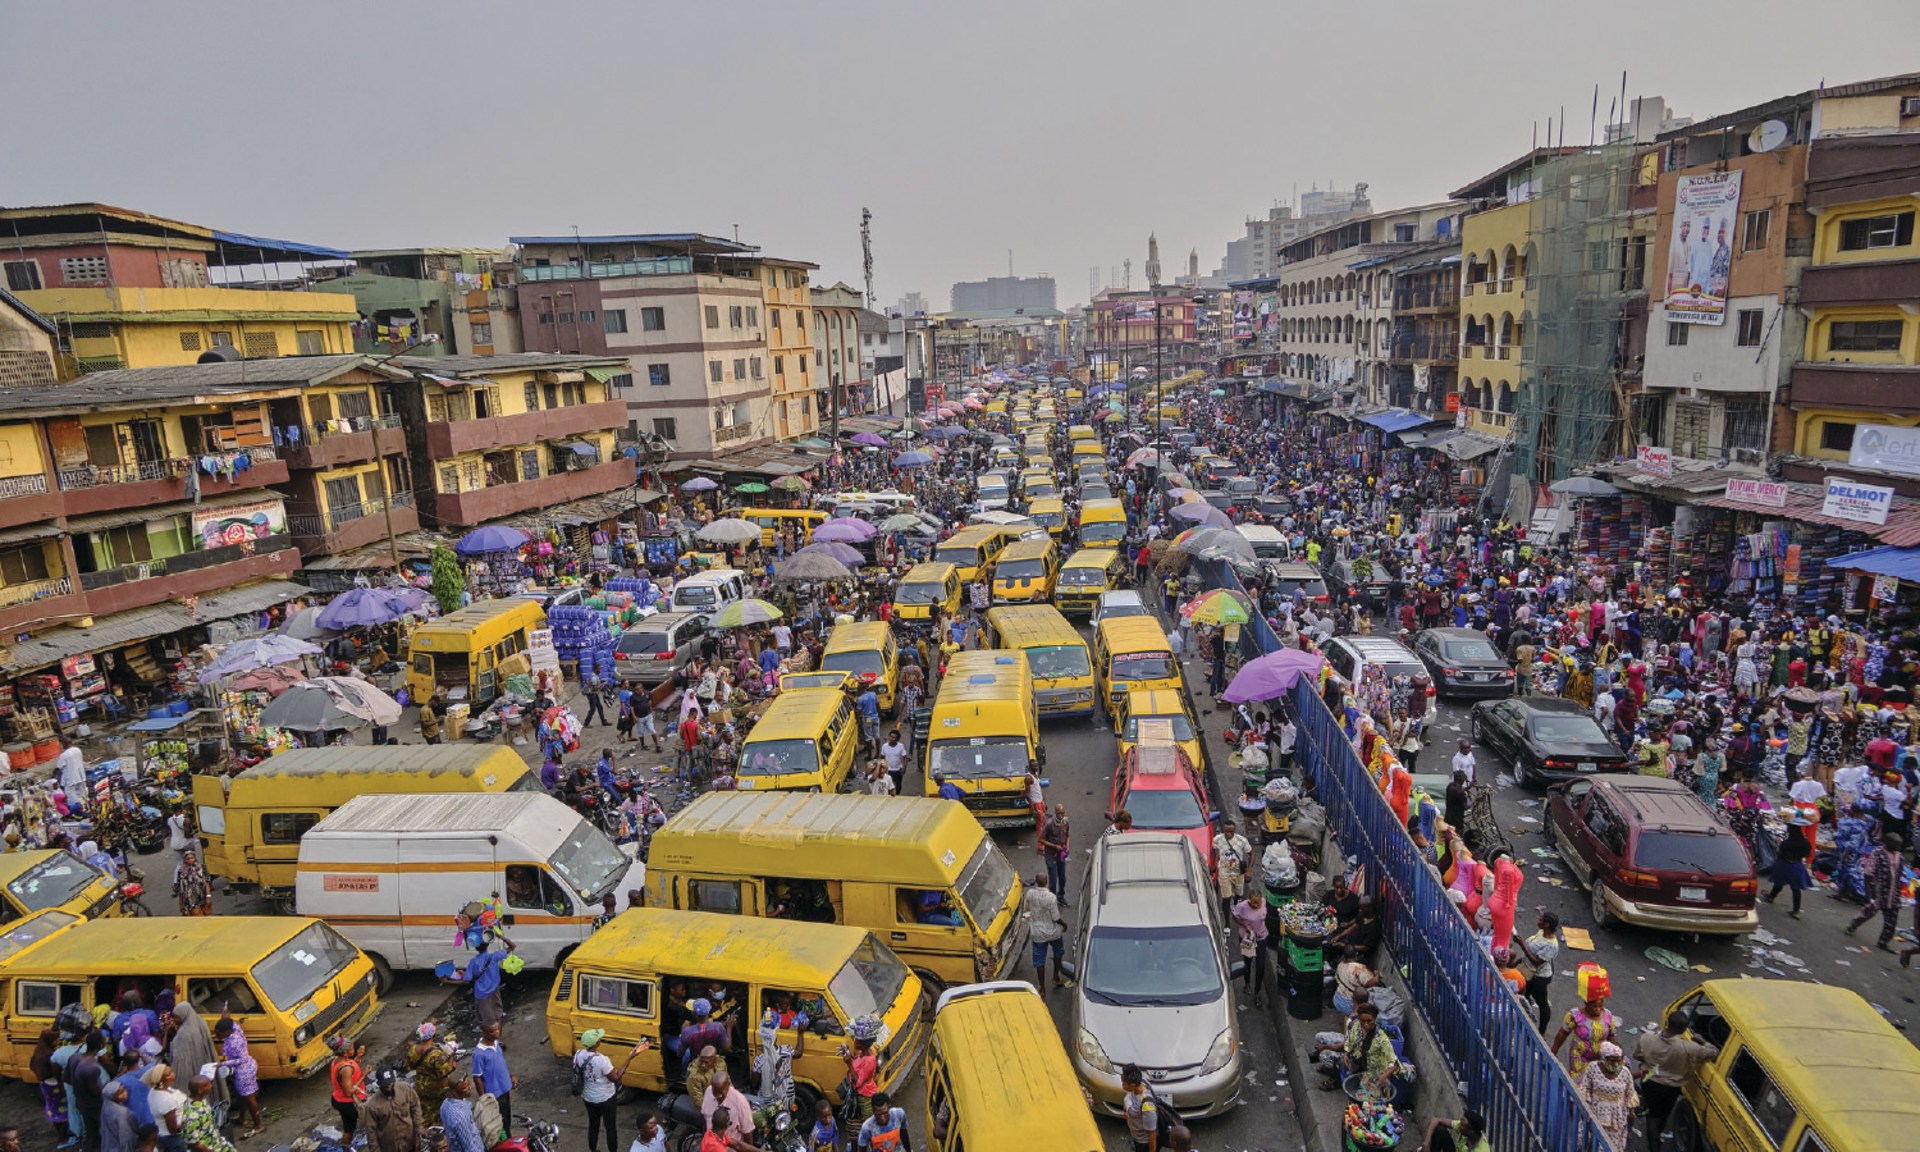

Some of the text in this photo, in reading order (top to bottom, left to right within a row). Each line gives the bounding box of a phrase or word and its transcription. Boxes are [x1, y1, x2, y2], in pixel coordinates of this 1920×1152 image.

[1729, 480, 1756, 493] DIVINE
[1757, 483, 1785, 497] MERCY
[1827, 485, 1888, 503] DELMOT
